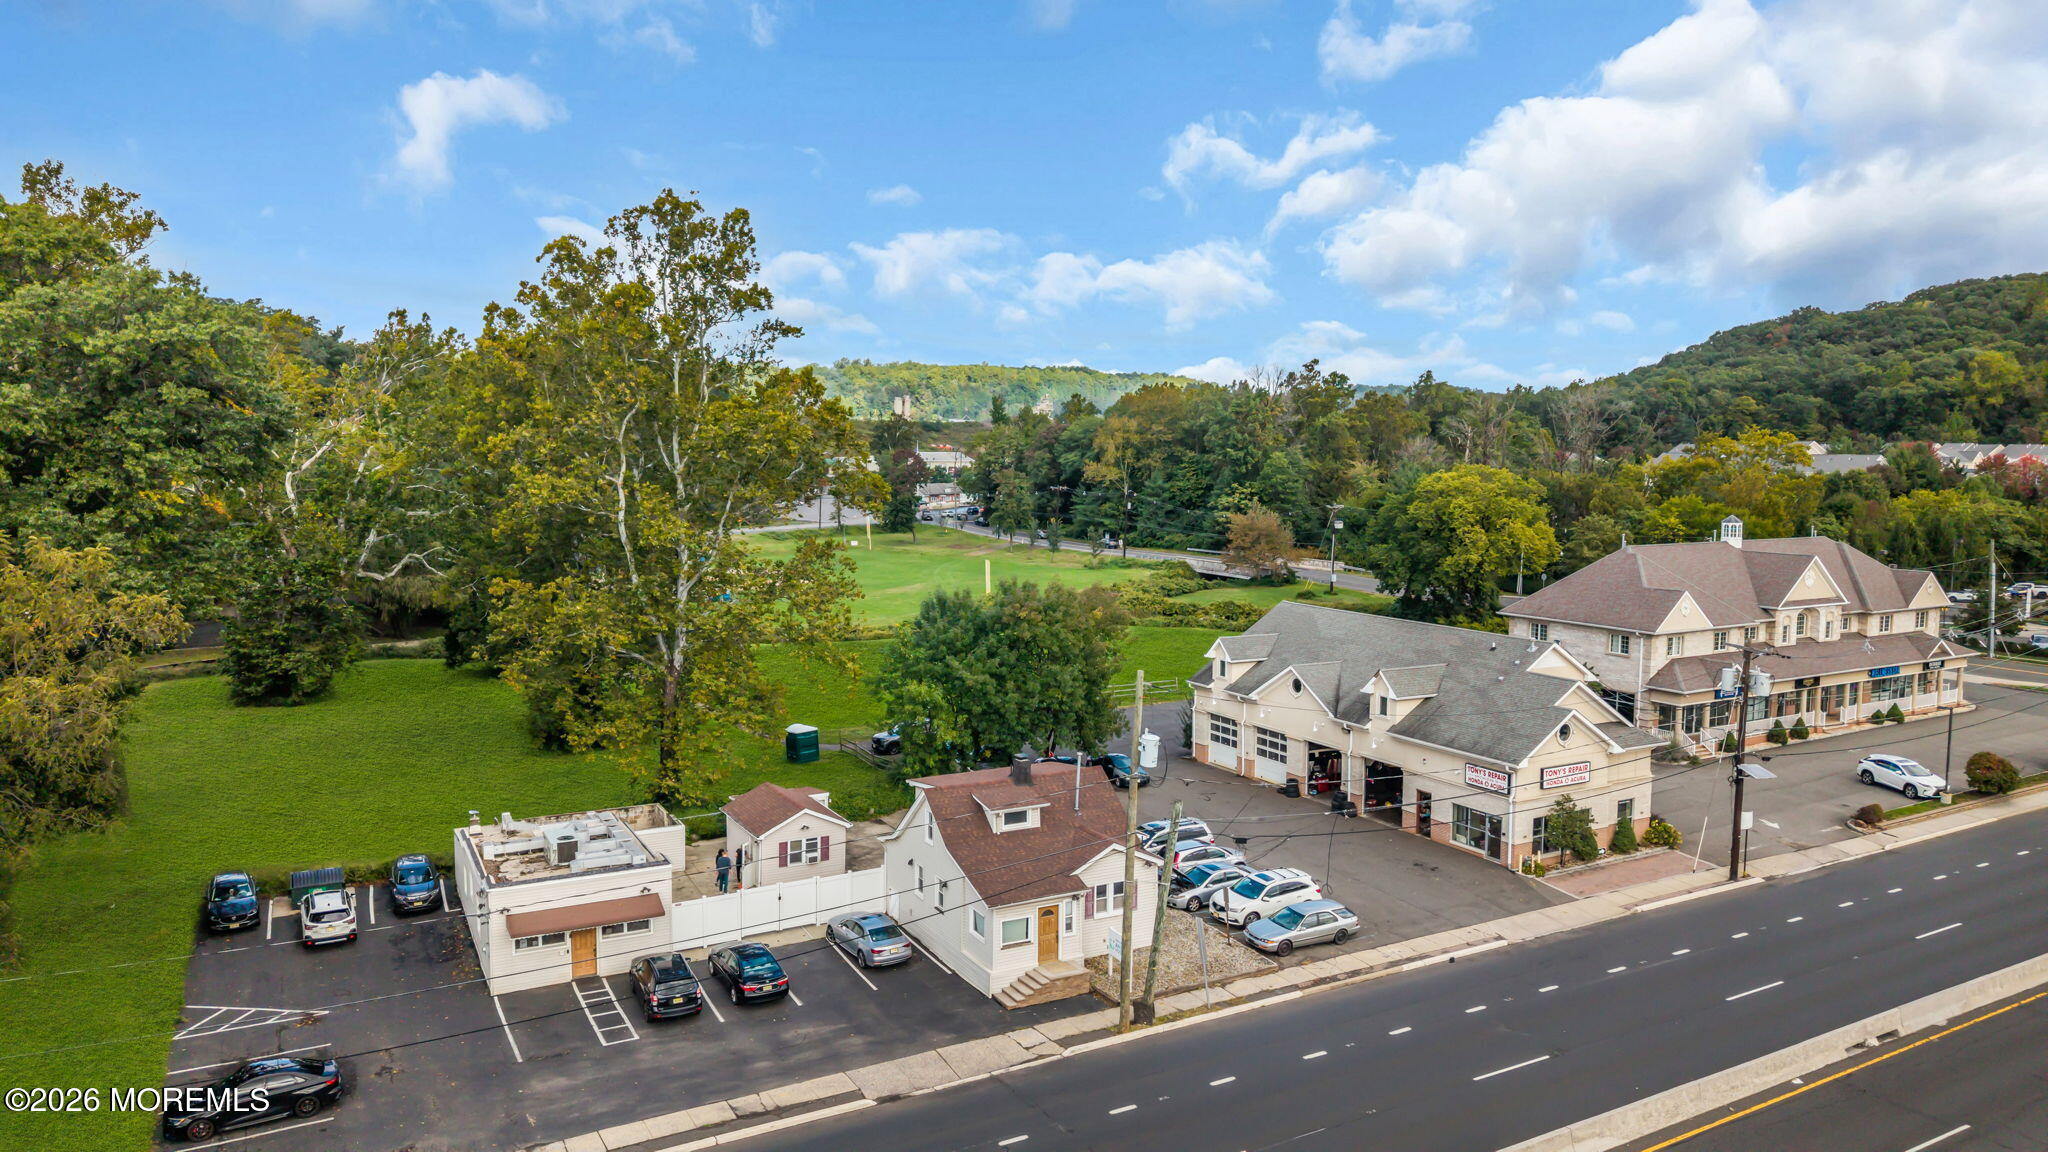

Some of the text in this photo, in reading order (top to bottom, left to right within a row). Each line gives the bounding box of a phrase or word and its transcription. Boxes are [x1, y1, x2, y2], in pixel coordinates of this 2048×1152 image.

[1467, 766, 1507, 782] TONY'S REPAIR
[1545, 764, 1588, 777] TONY'S REPAIR
